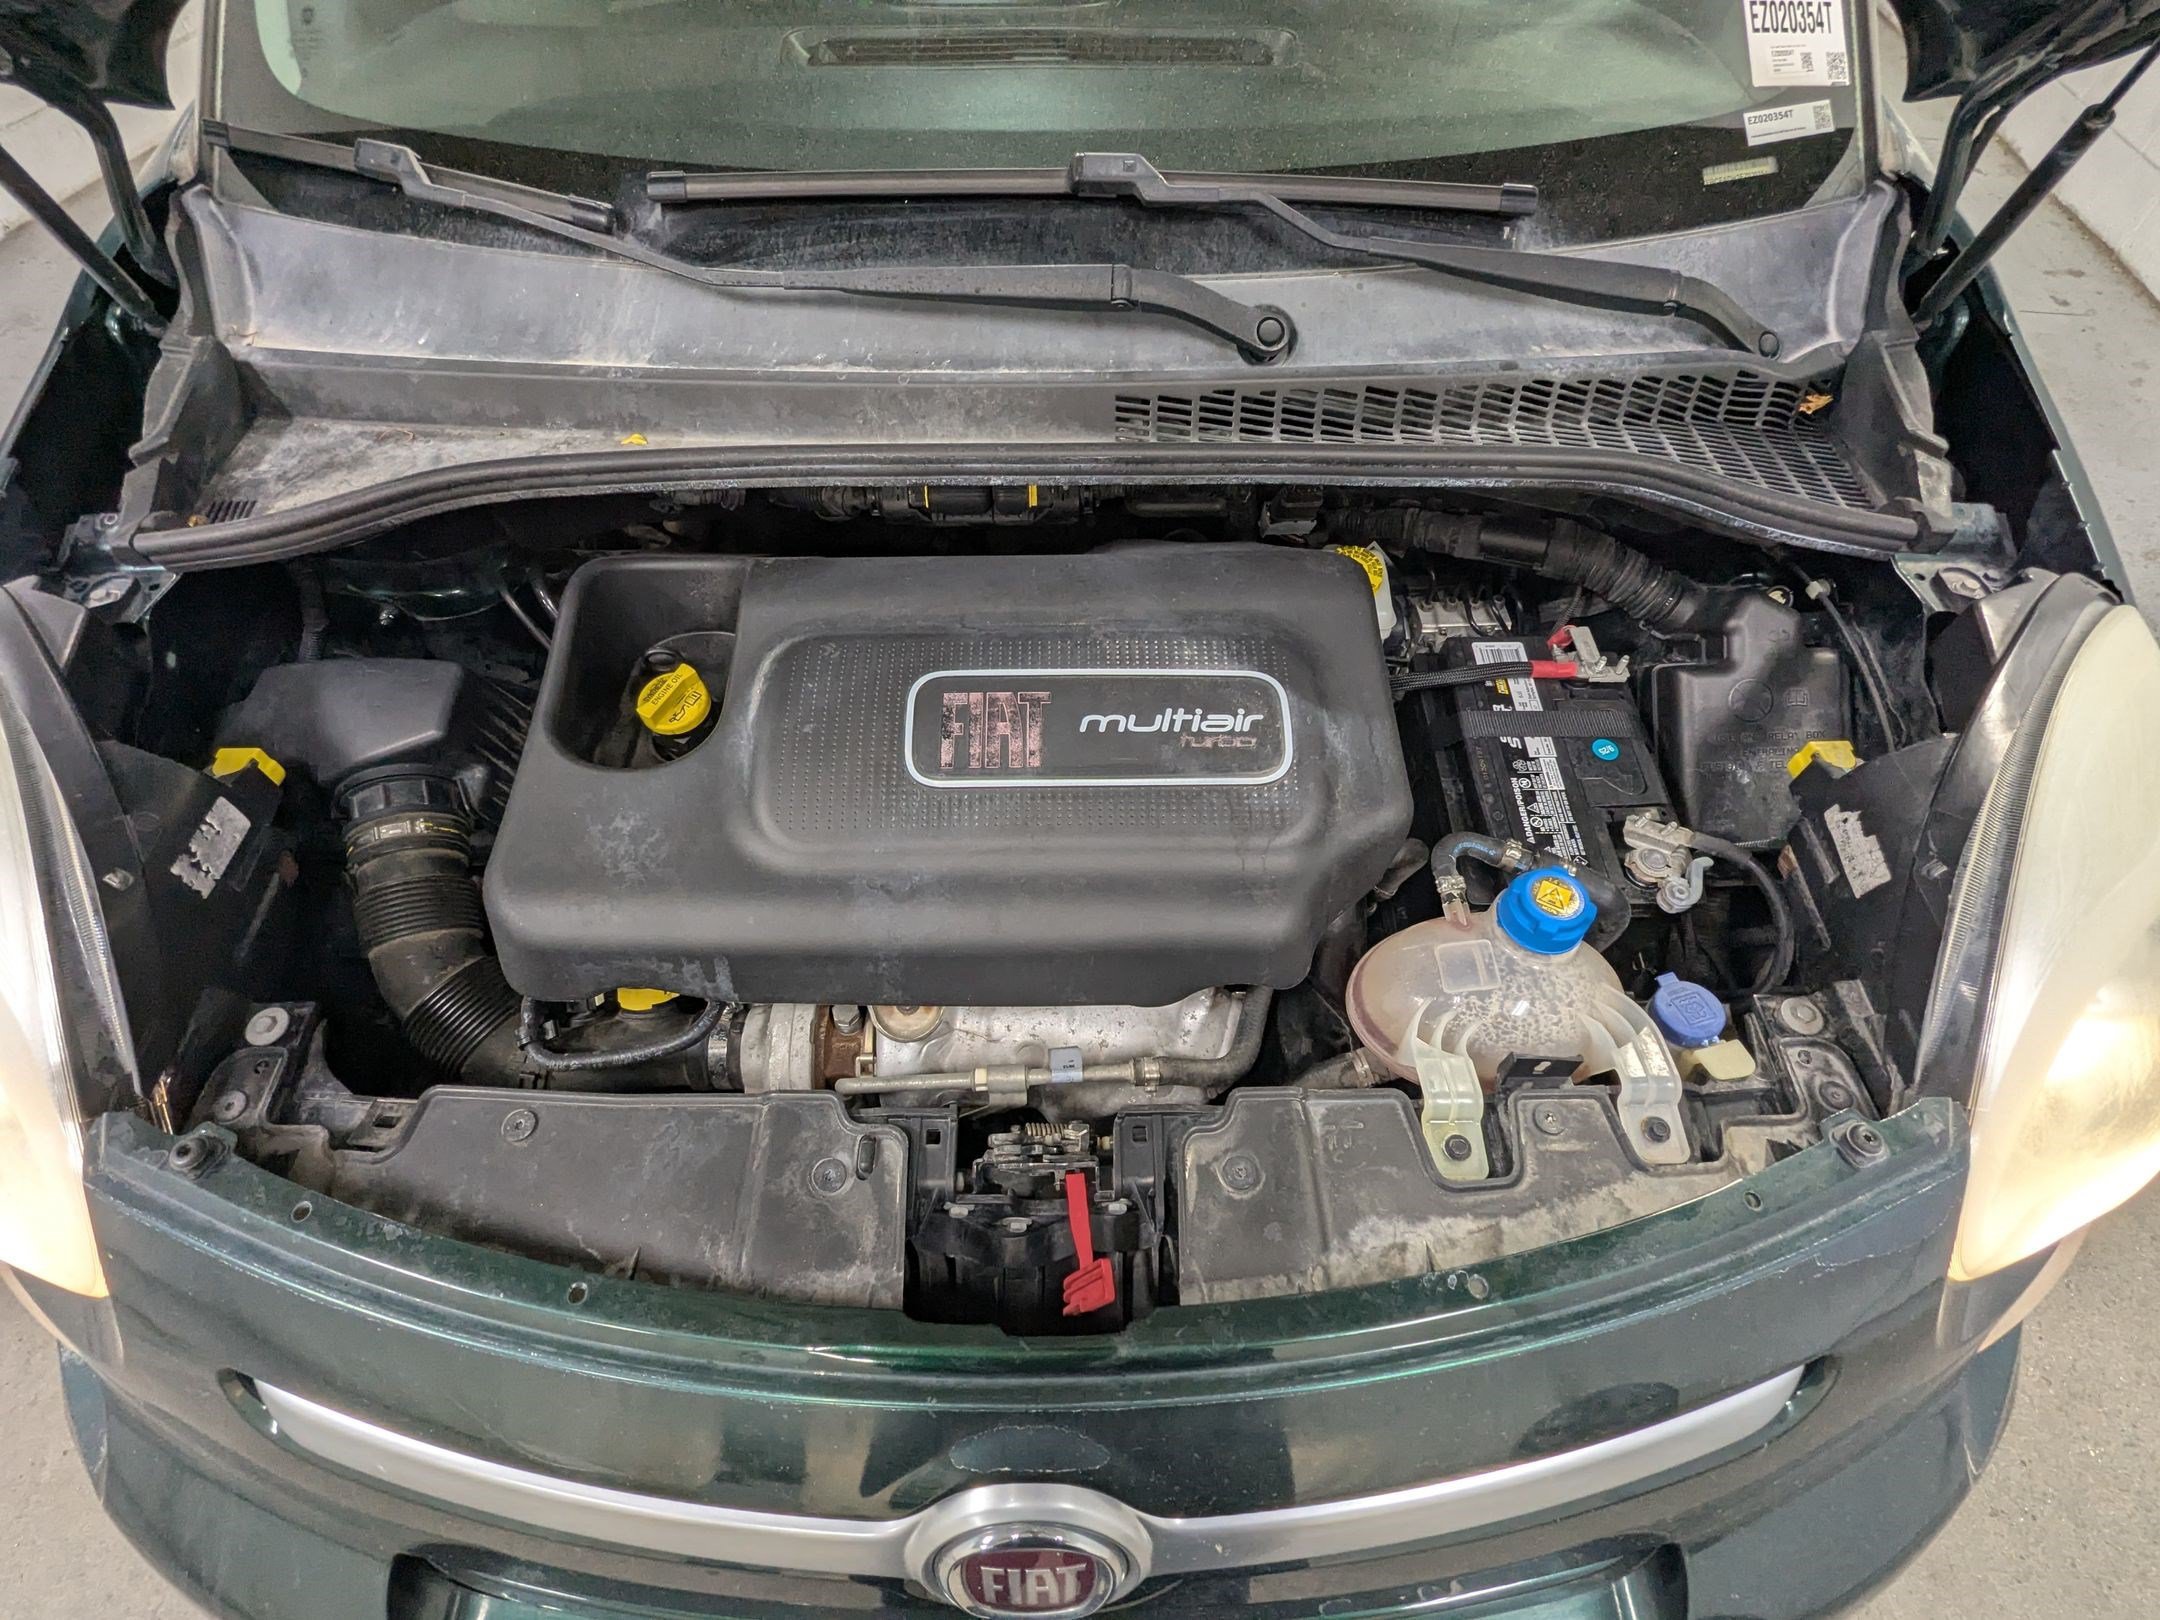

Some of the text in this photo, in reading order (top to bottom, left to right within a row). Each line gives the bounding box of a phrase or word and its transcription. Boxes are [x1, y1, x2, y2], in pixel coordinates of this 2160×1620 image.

[1750, 1, 1832, 33] EZ020354T
[1747, 109, 1793, 125] EZ020354T
[651, 673, 682, 705] ENGINE OIL
[939, 691, 1052, 769] FIAT
[1079, 707, 1264, 734] multiair
[1805, 730, 1825, 740] BOX
[1179, 733, 1258, 750] turbo
[1510, 777, 1535, 838] DANGER/POISON
[980, 1563, 1087, 1606] FIAT
